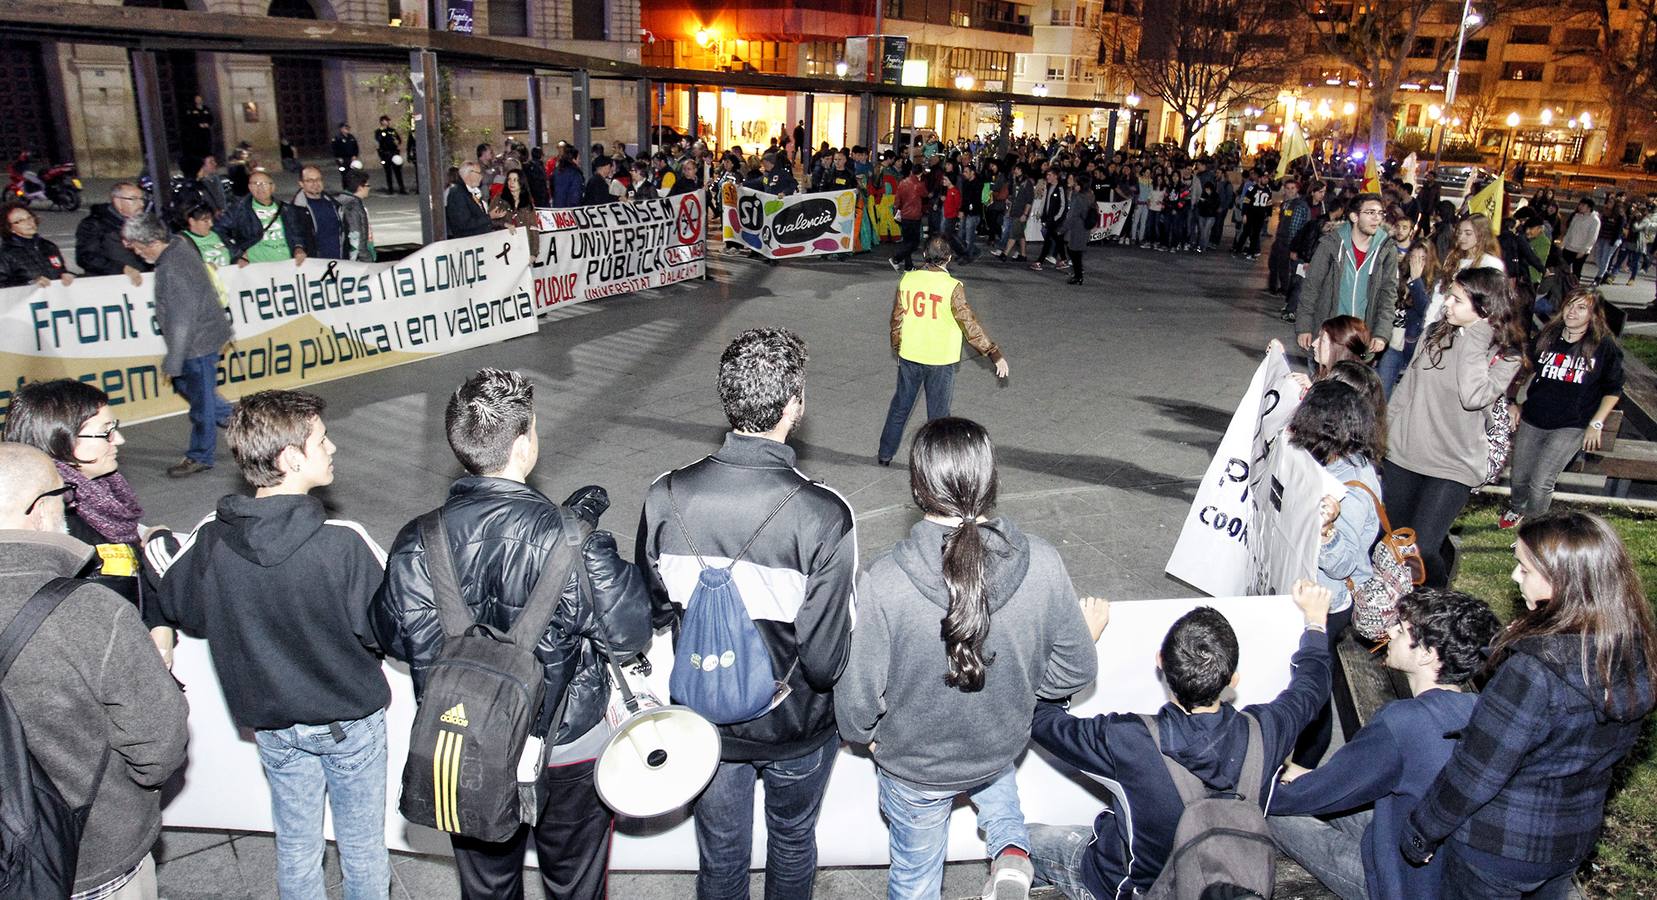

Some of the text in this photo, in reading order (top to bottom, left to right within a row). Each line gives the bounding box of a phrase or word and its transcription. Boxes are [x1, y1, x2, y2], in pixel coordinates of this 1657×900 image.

[1253, 190, 1269, 207] 10
[573, 199, 675, 230] DEFENSEM
[774, 209, 833, 236] valencià
[532, 236, 558, 268] LA
[667, 248, 682, 264] 24
[29, 293, 139, 352] Front
[239, 270, 373, 324] retallades
[391, 265, 417, 298] la
[899, 289, 943, 320] UGT
[299, 321, 392, 380] pública
[407, 313, 438, 346] en
[444, 285, 534, 338] valencià
[440, 713, 469, 728] adidas
